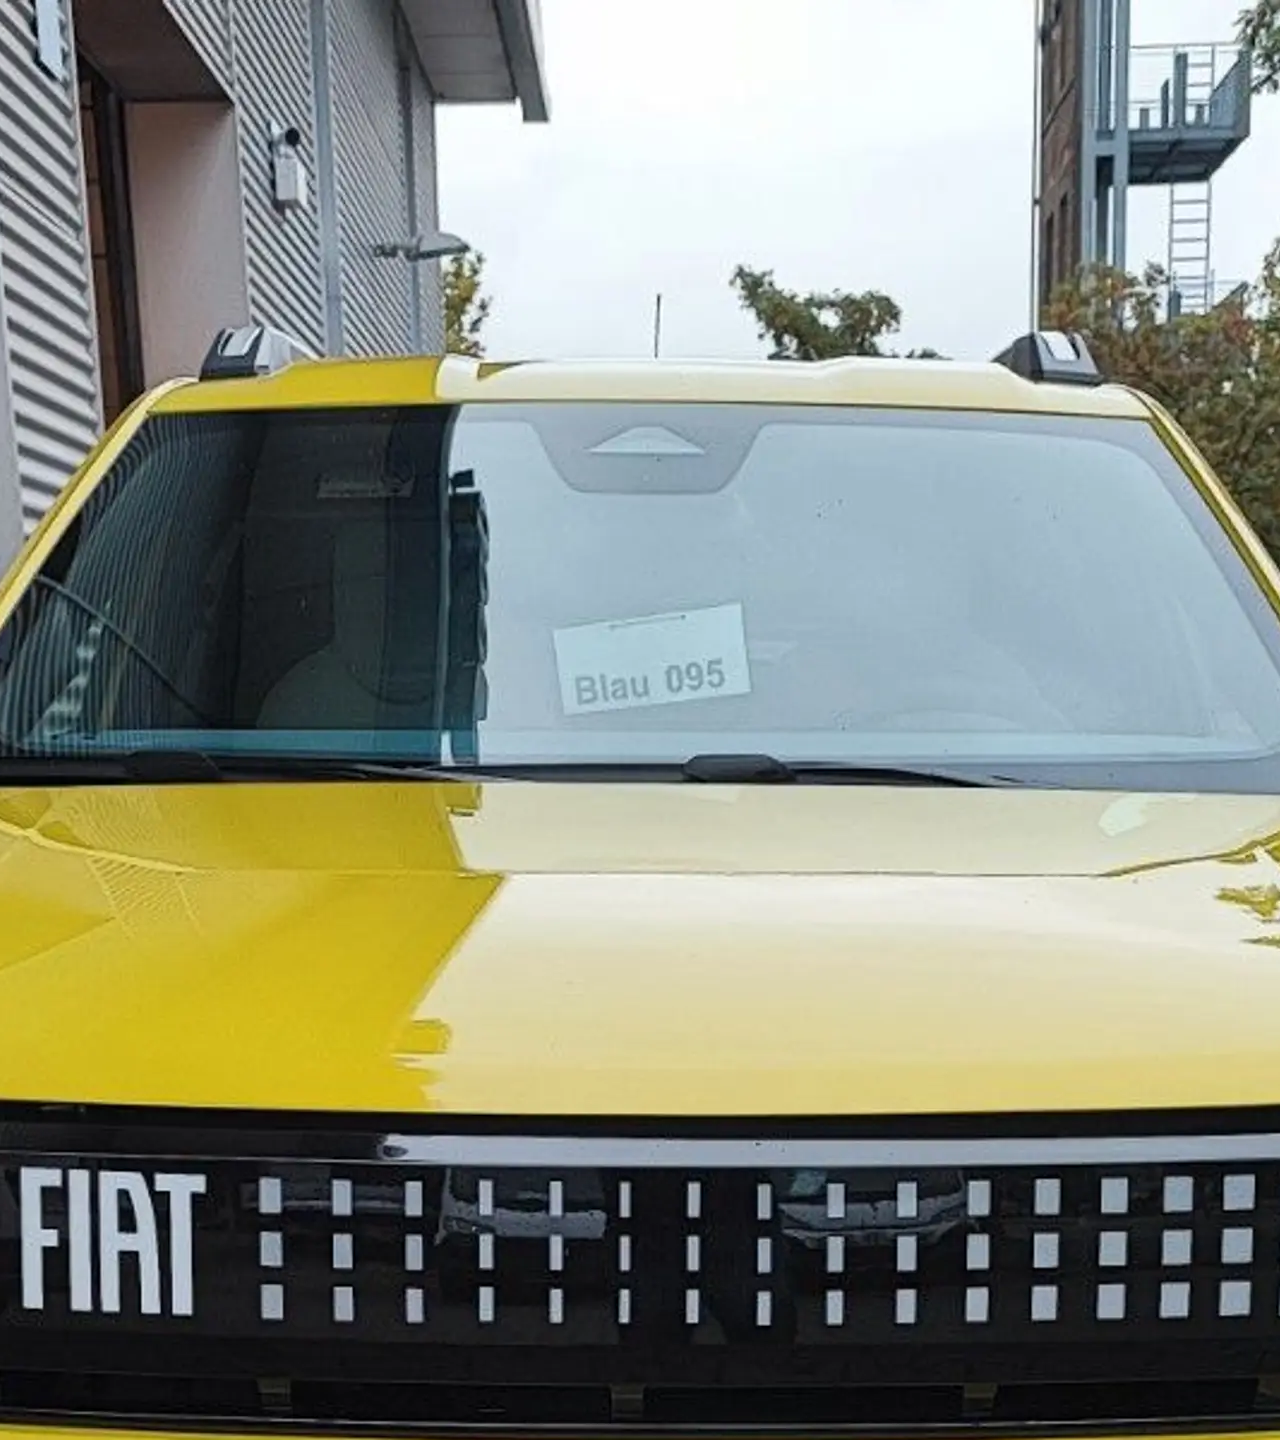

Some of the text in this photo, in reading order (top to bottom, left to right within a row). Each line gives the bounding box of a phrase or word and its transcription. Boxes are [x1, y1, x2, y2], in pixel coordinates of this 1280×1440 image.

[574, 657, 727, 706] Blau 095
[20, 1166, 207, 1316] FIAT
